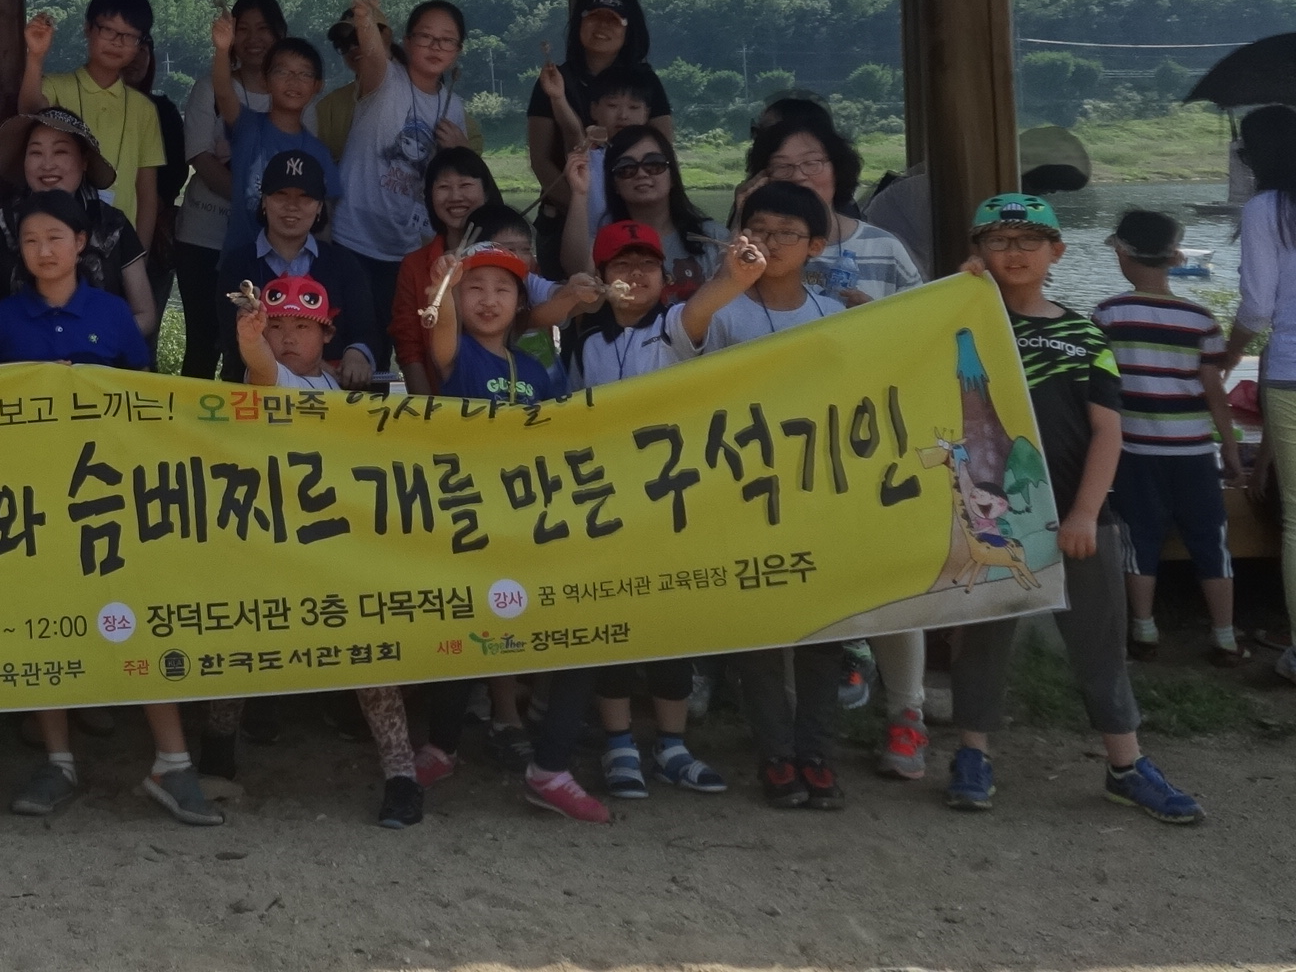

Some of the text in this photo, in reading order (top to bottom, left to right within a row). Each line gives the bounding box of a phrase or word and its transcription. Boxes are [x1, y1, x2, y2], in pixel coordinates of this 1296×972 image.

[1016, 335, 1087, 357] ocharge
[487, 377, 534, 397] GUSS
[71, 390, 174, 423] 느끼는!
[196, 389, 329, 425] 오감만족
[500, 446, 623, 544] 만든
[632, 385, 921, 532] 구석기인
[493, 590, 523, 609] 강사
[563, 575, 651, 604] 역사도서관
[658, 566, 728, 592] 교육팀장
[734, 551, 817, 590] 김은주
[25, 615, 88, 640] 12:00
[103, 585, 475, 638] 장소 장덕도서관 3층 다목적실
[437, 622, 630, 655] 시행 장덕도서관
[123, 659, 150, 676] 주관
